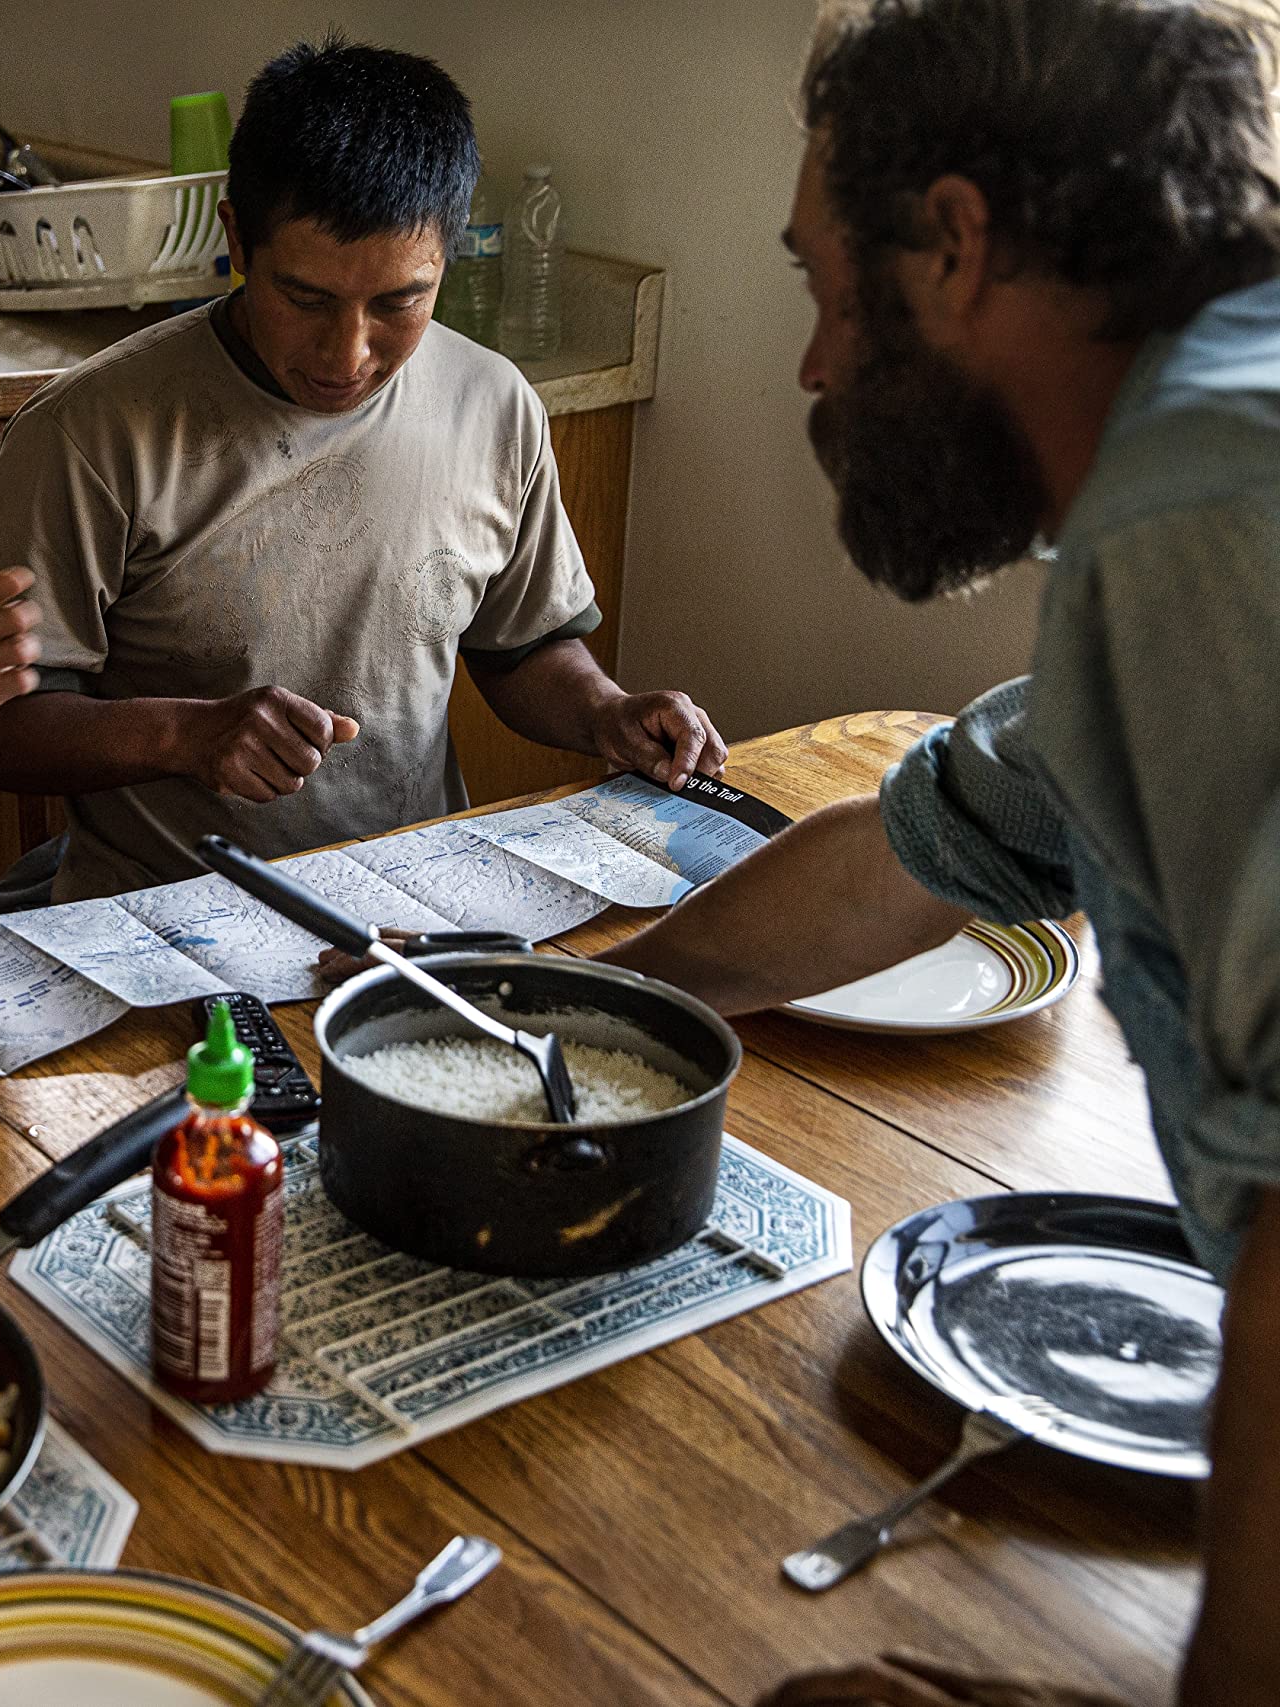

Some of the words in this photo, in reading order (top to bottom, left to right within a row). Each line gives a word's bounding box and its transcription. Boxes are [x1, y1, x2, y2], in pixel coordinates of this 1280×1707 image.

[444, 548, 457, 557] DEL
[699, 781, 718, 794] the
[717, 788, 744, 803] Trail
